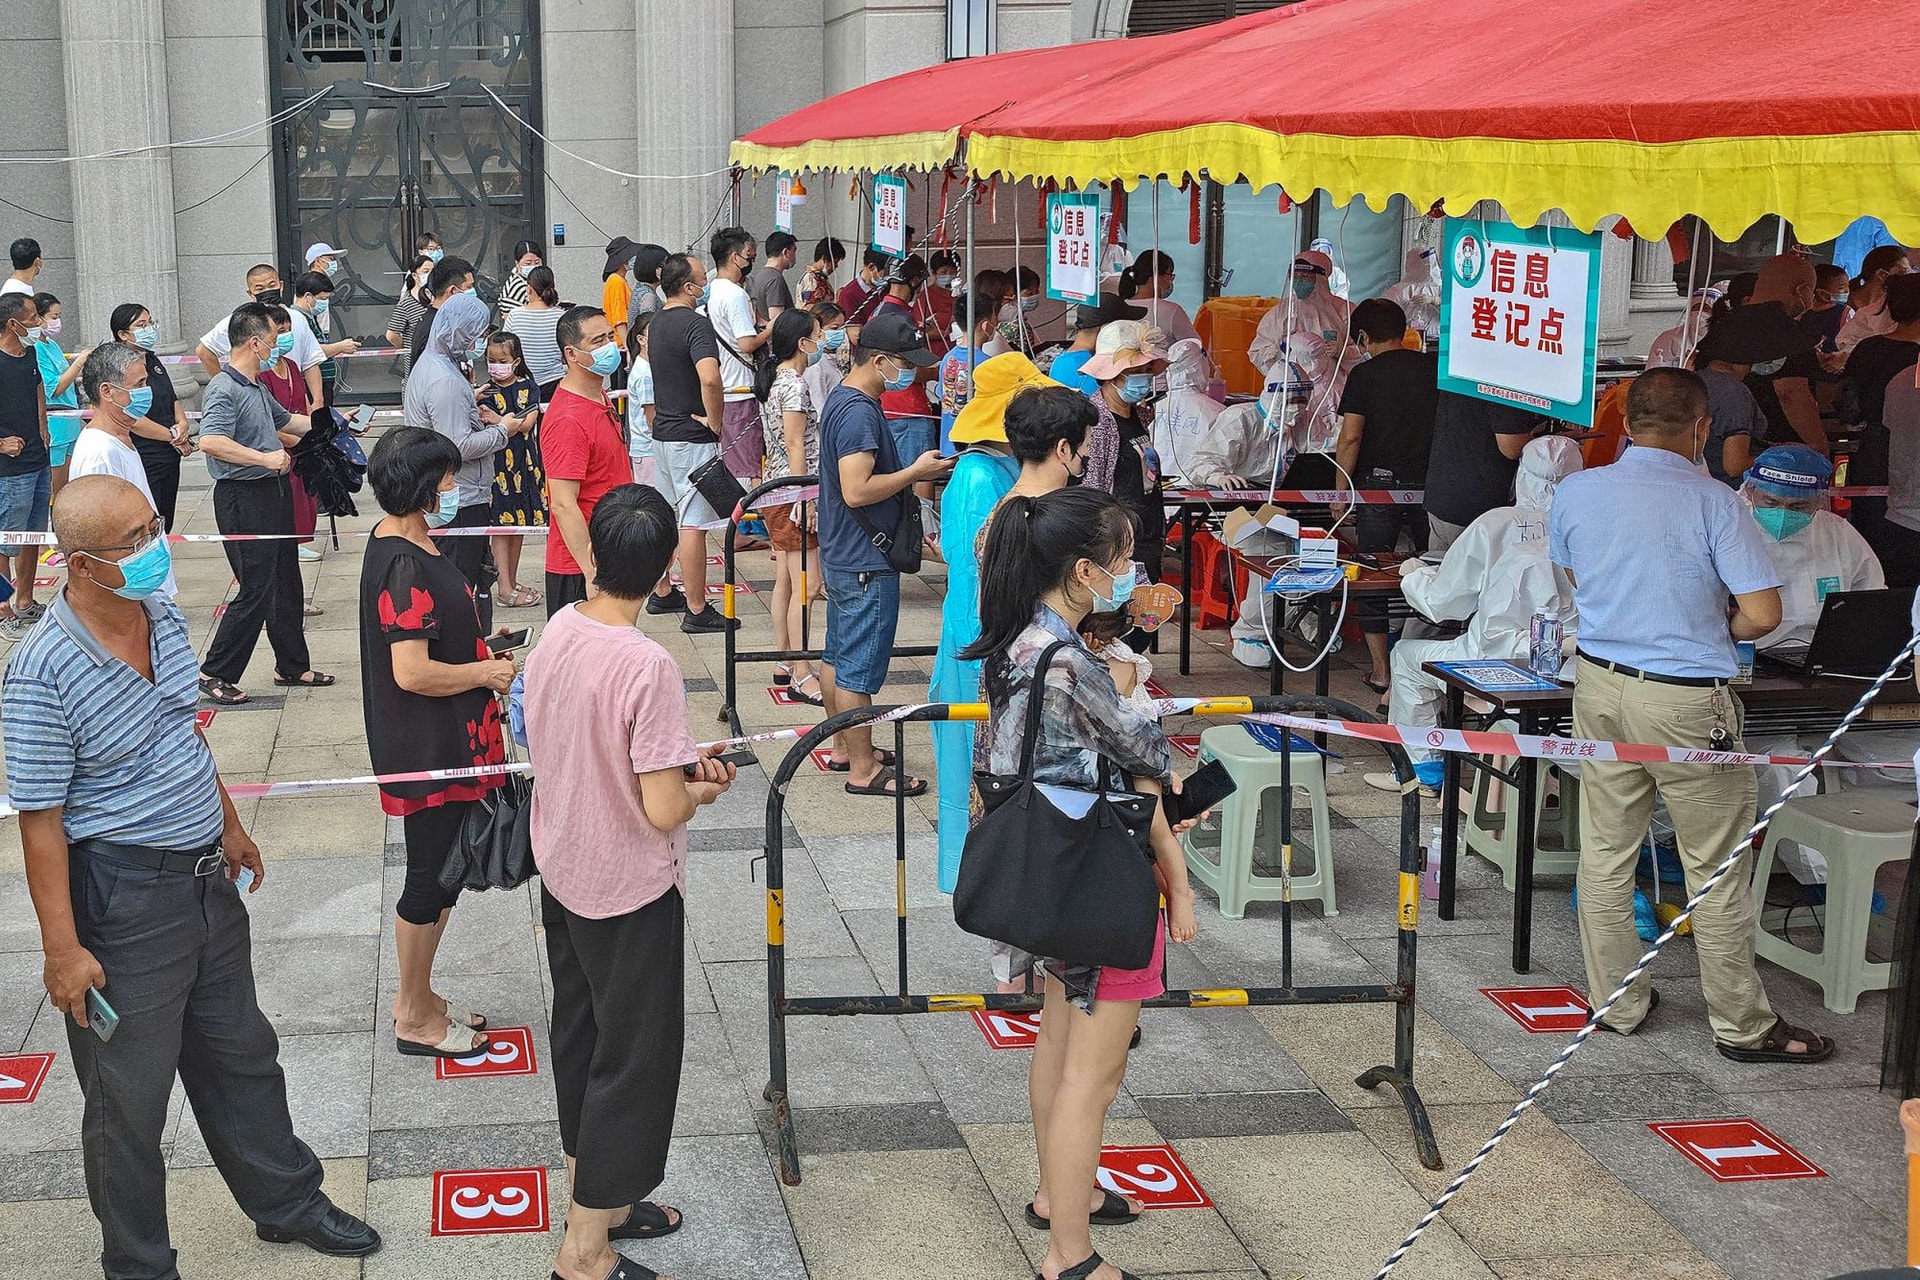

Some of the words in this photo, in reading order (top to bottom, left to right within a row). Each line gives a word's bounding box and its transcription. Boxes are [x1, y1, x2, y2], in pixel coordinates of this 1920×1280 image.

[1064, 209, 1084, 236] 信息
[1058, 239, 1089, 268] 登记点
[1490, 248, 1550, 298] 信息
[1471, 297, 1565, 355] 登记点
[1762, 469, 1781, 478] Face
[1785, 474, 1813, 483] Shield
[3, 533, 23, 544] LINE
[24, 533, 46, 544] LIMIT
[1540, 738, 1597, 757] 警戒线
[1683, 751, 1722, 762] LIMIT
[1688, 1139, 1782, 1167] 1
[1096, 1163, 1178, 1195] 2
[450, 1186, 530, 1219] 3
